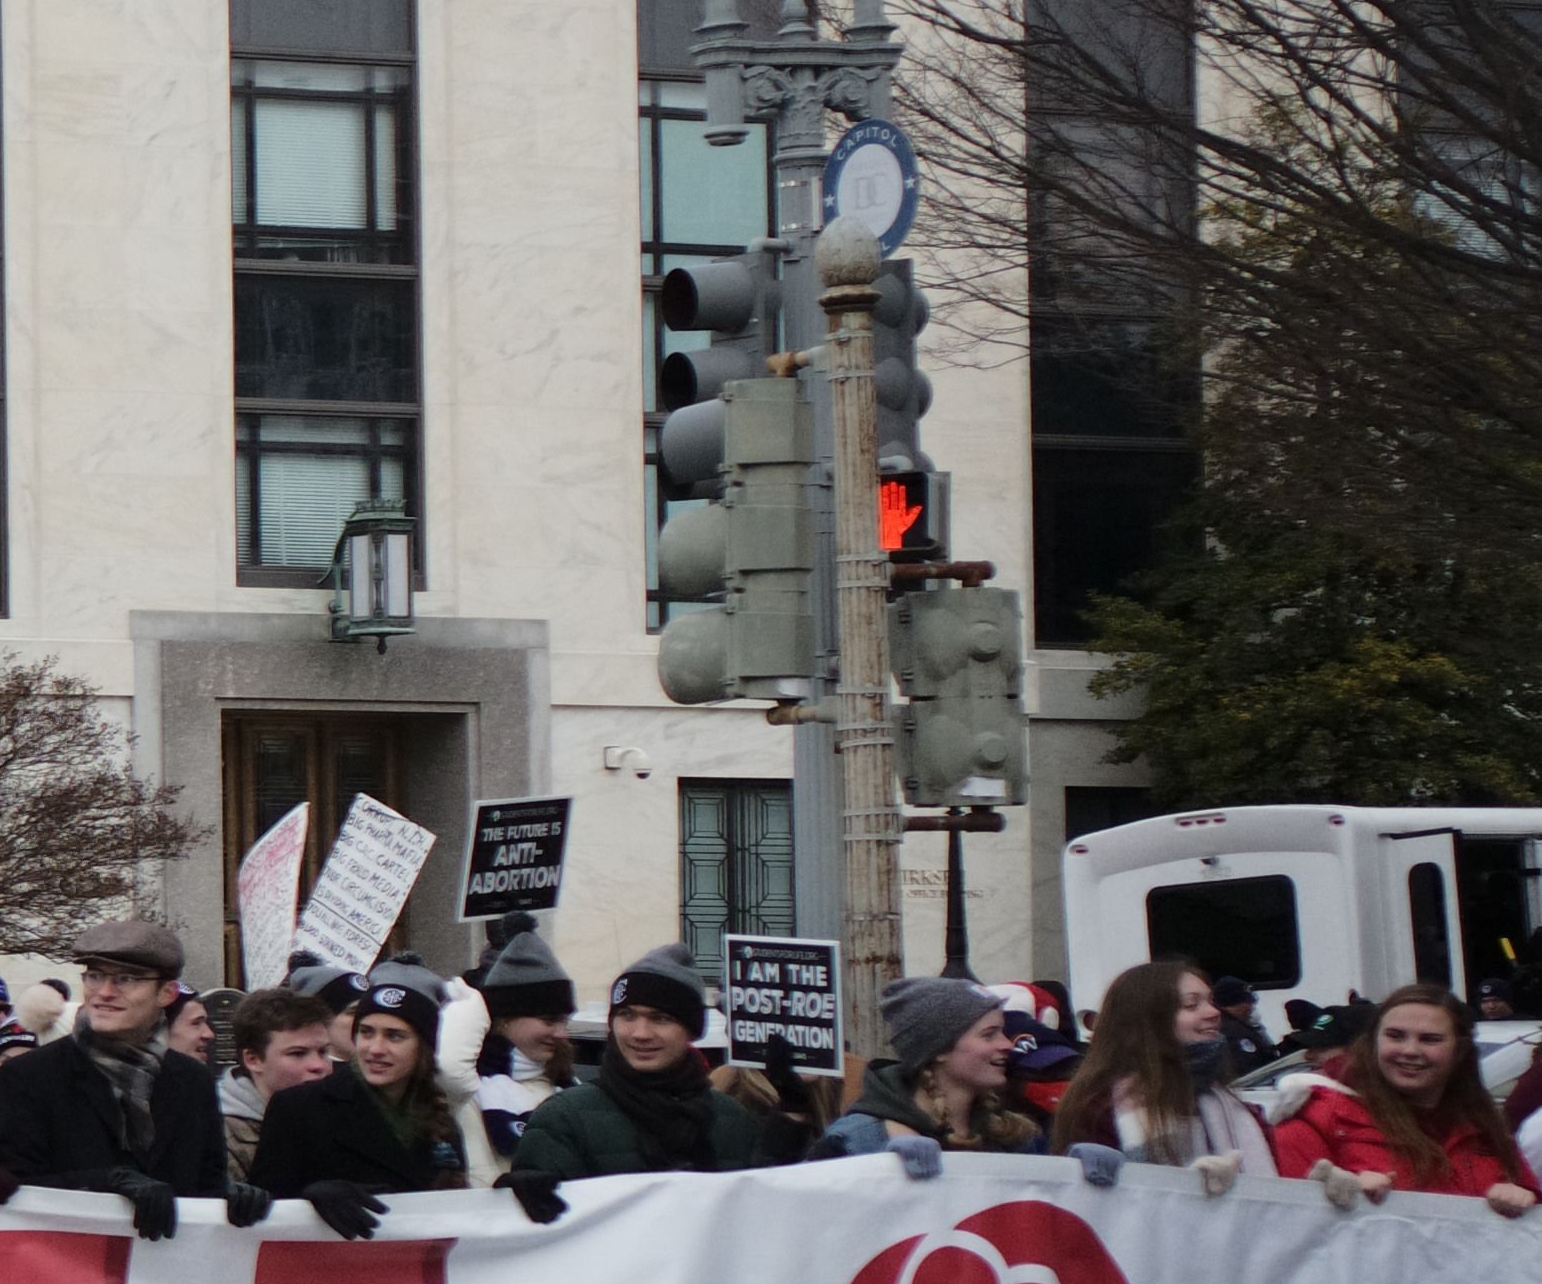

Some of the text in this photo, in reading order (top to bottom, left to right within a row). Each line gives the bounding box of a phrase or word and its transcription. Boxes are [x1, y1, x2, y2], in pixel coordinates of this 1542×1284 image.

[836, 126, 897, 160] CAPITOL
[483, 826, 505, 841] THE
[507, 823, 549, 840] FUTURE
[468, 865, 561, 895] ABORTION
[900, 869, 949, 885] IRKS
[735, 959, 828, 987] I AM THE
[731, 986, 836, 1019] POST-ROE
